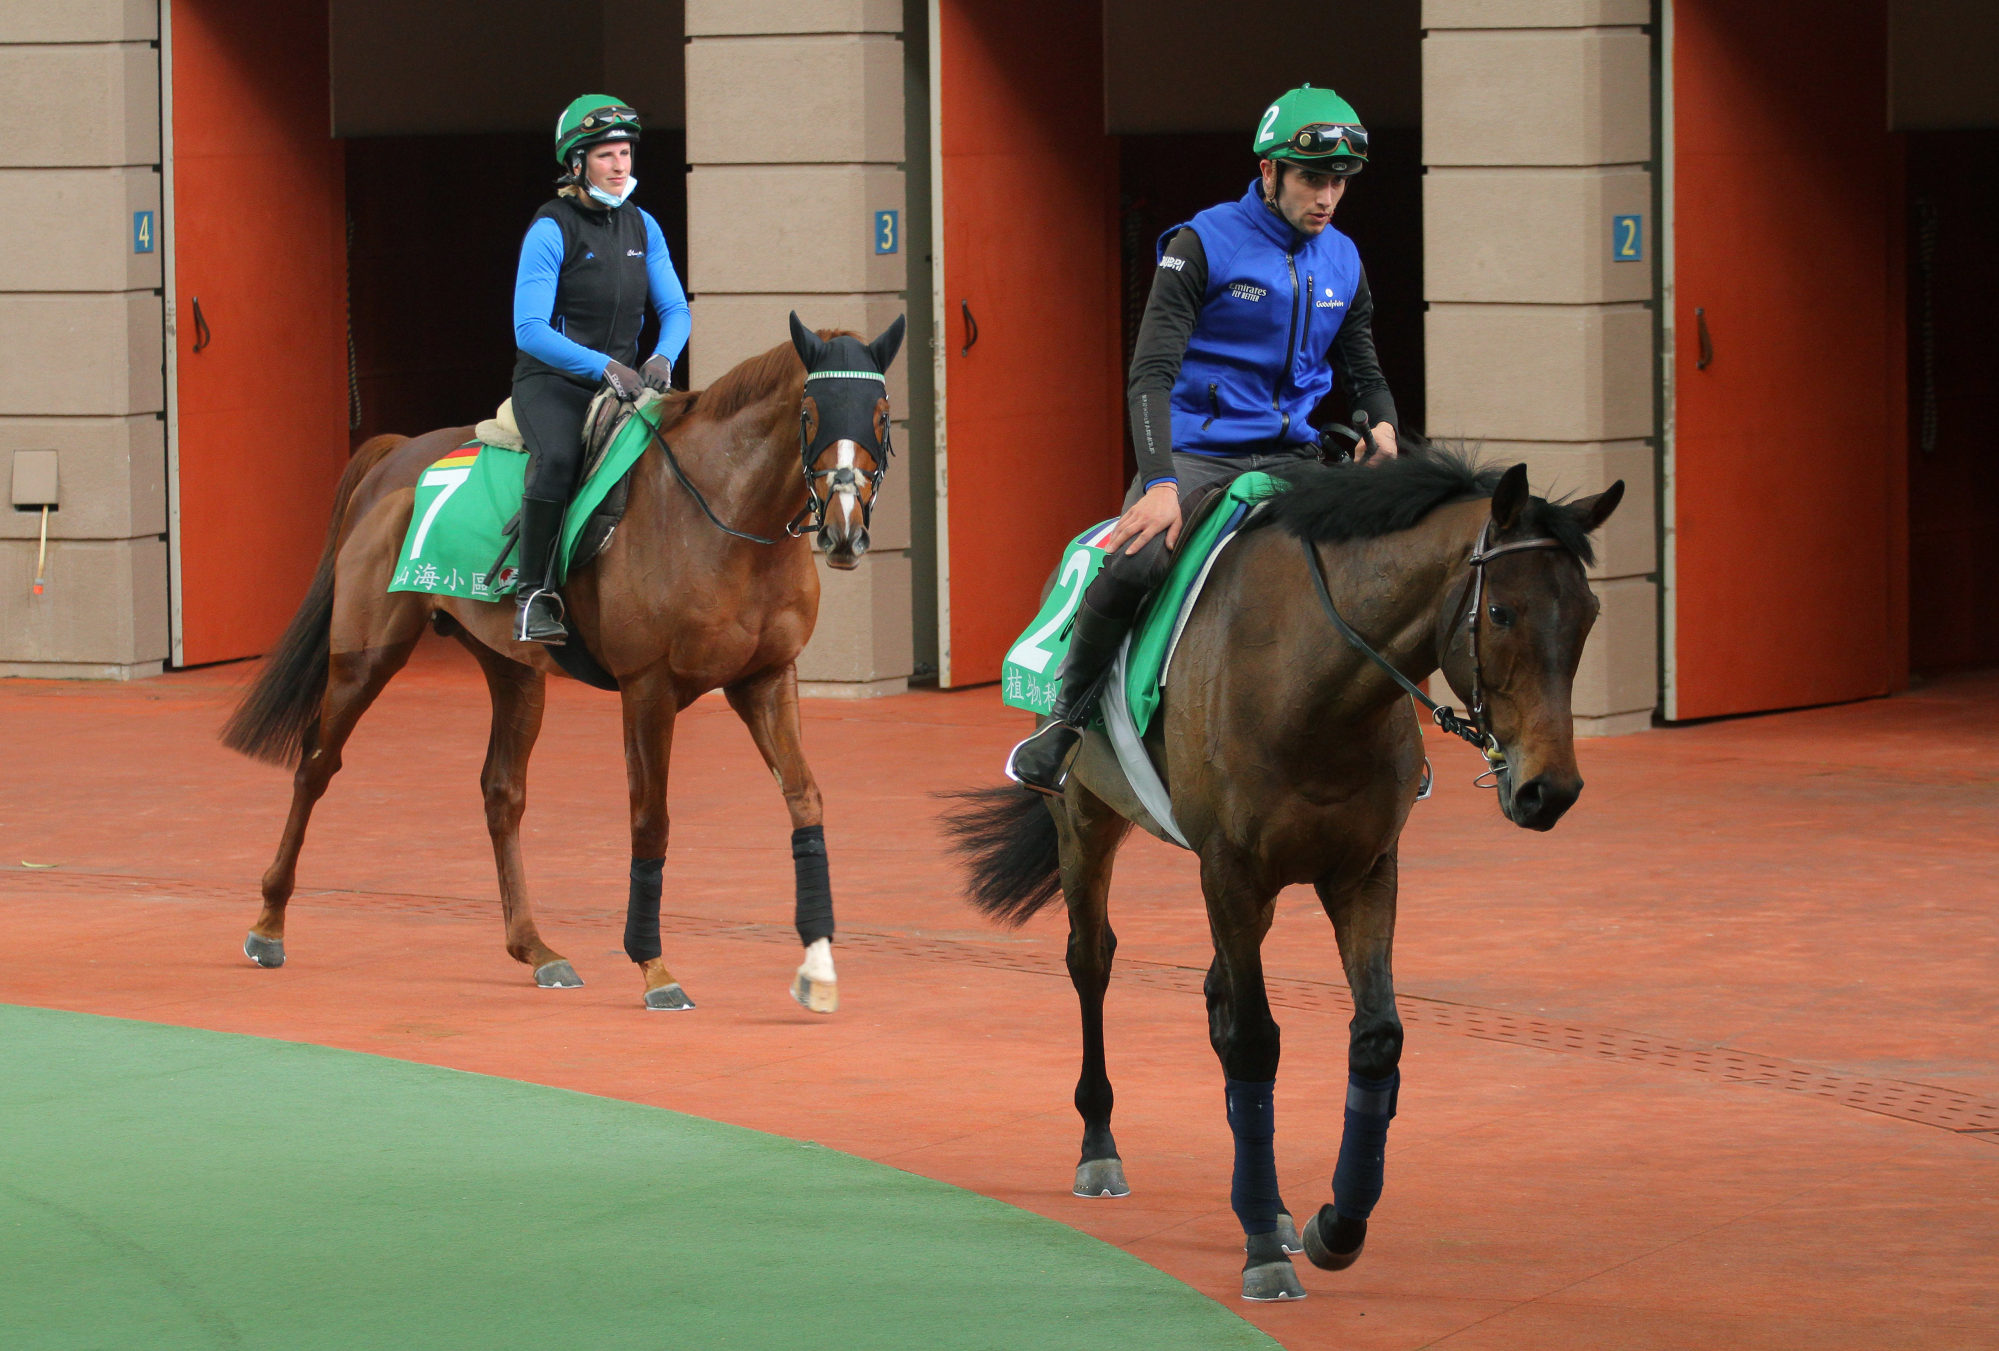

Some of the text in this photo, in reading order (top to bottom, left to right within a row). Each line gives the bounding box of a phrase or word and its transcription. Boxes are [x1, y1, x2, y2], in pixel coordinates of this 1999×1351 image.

[1259, 105, 1280, 144] 2
[139, 215, 150, 249] 4
[881, 214, 893, 250] 3
[1622, 219, 1636, 256] 2
[1229, 281, 1267, 297] Emirates
[1231, 289, 1260, 303] FLY BETTER
[1316, 299, 1344, 310] Godolphin
[410, 468, 472, 561] 7
[394, 562, 489, 597] 山海小區
[1007, 549, 1091, 675] 2
